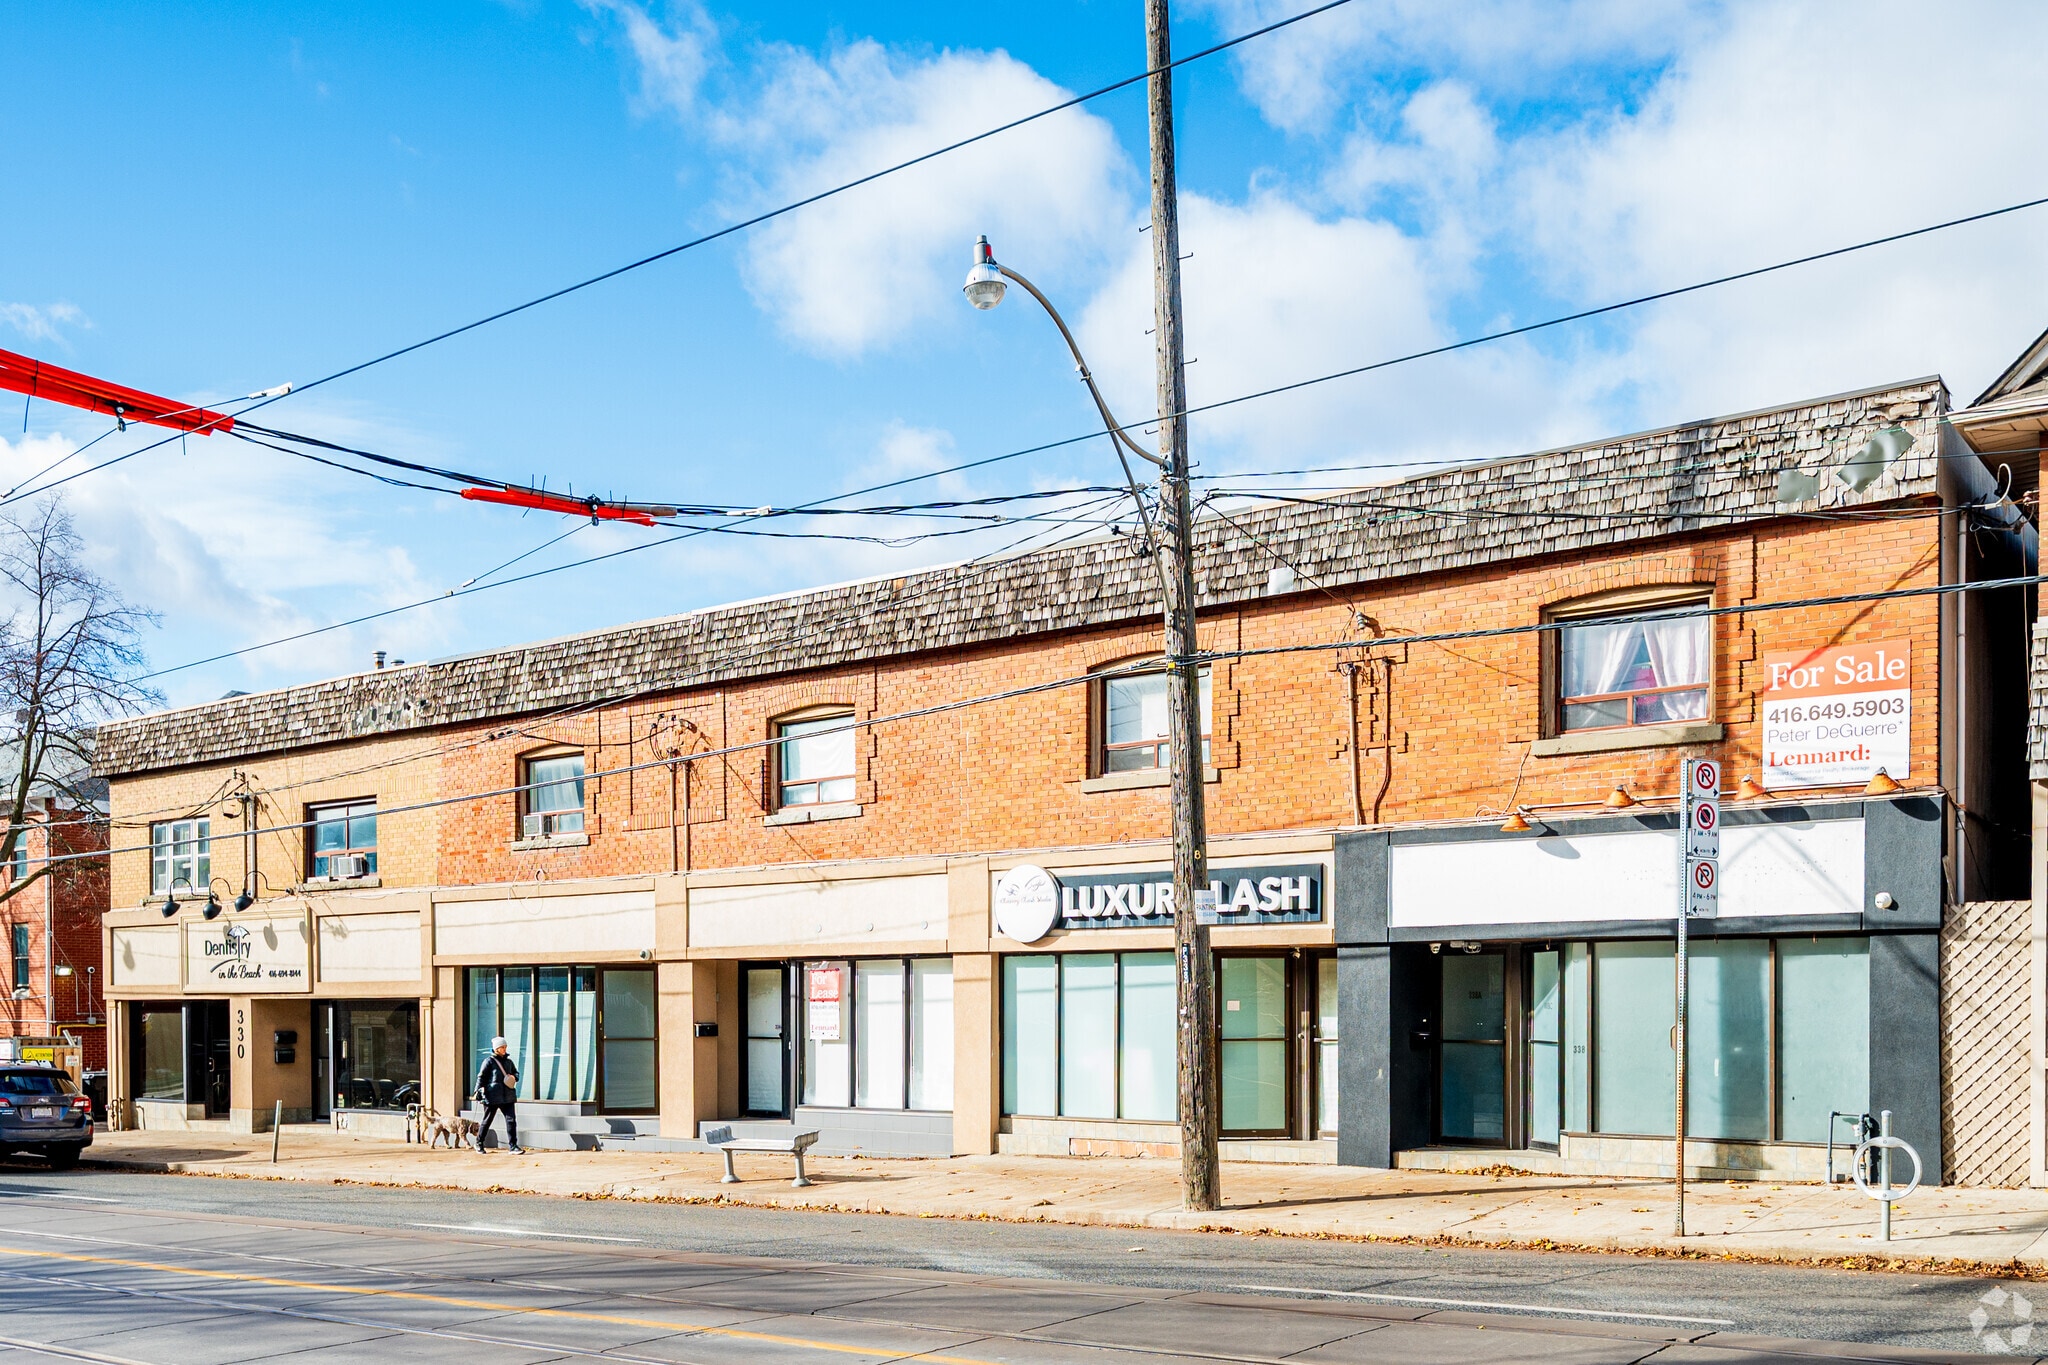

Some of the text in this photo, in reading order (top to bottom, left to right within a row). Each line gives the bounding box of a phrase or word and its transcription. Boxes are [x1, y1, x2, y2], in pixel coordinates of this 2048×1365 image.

[1769, 650, 1906, 691] For Sale
[1768, 698, 1905, 724] 416.649.5903
[1768, 729, 1811, 744] Peter
[1769, 743, 1871, 768] Lennard:
[1062, 875, 1311, 918] LUXUR LASH
[204, 938, 251, 960] Dentistry
[218, 969, 226, 979] in
[227, 964, 238, 979] the
[238, 964, 261, 979] Beach
[811, 972, 828, 985] For
[811, 986, 839, 999] Lease
[237, 1009, 245, 1059] 330
[1573, 1045, 1586, 1054] 338
